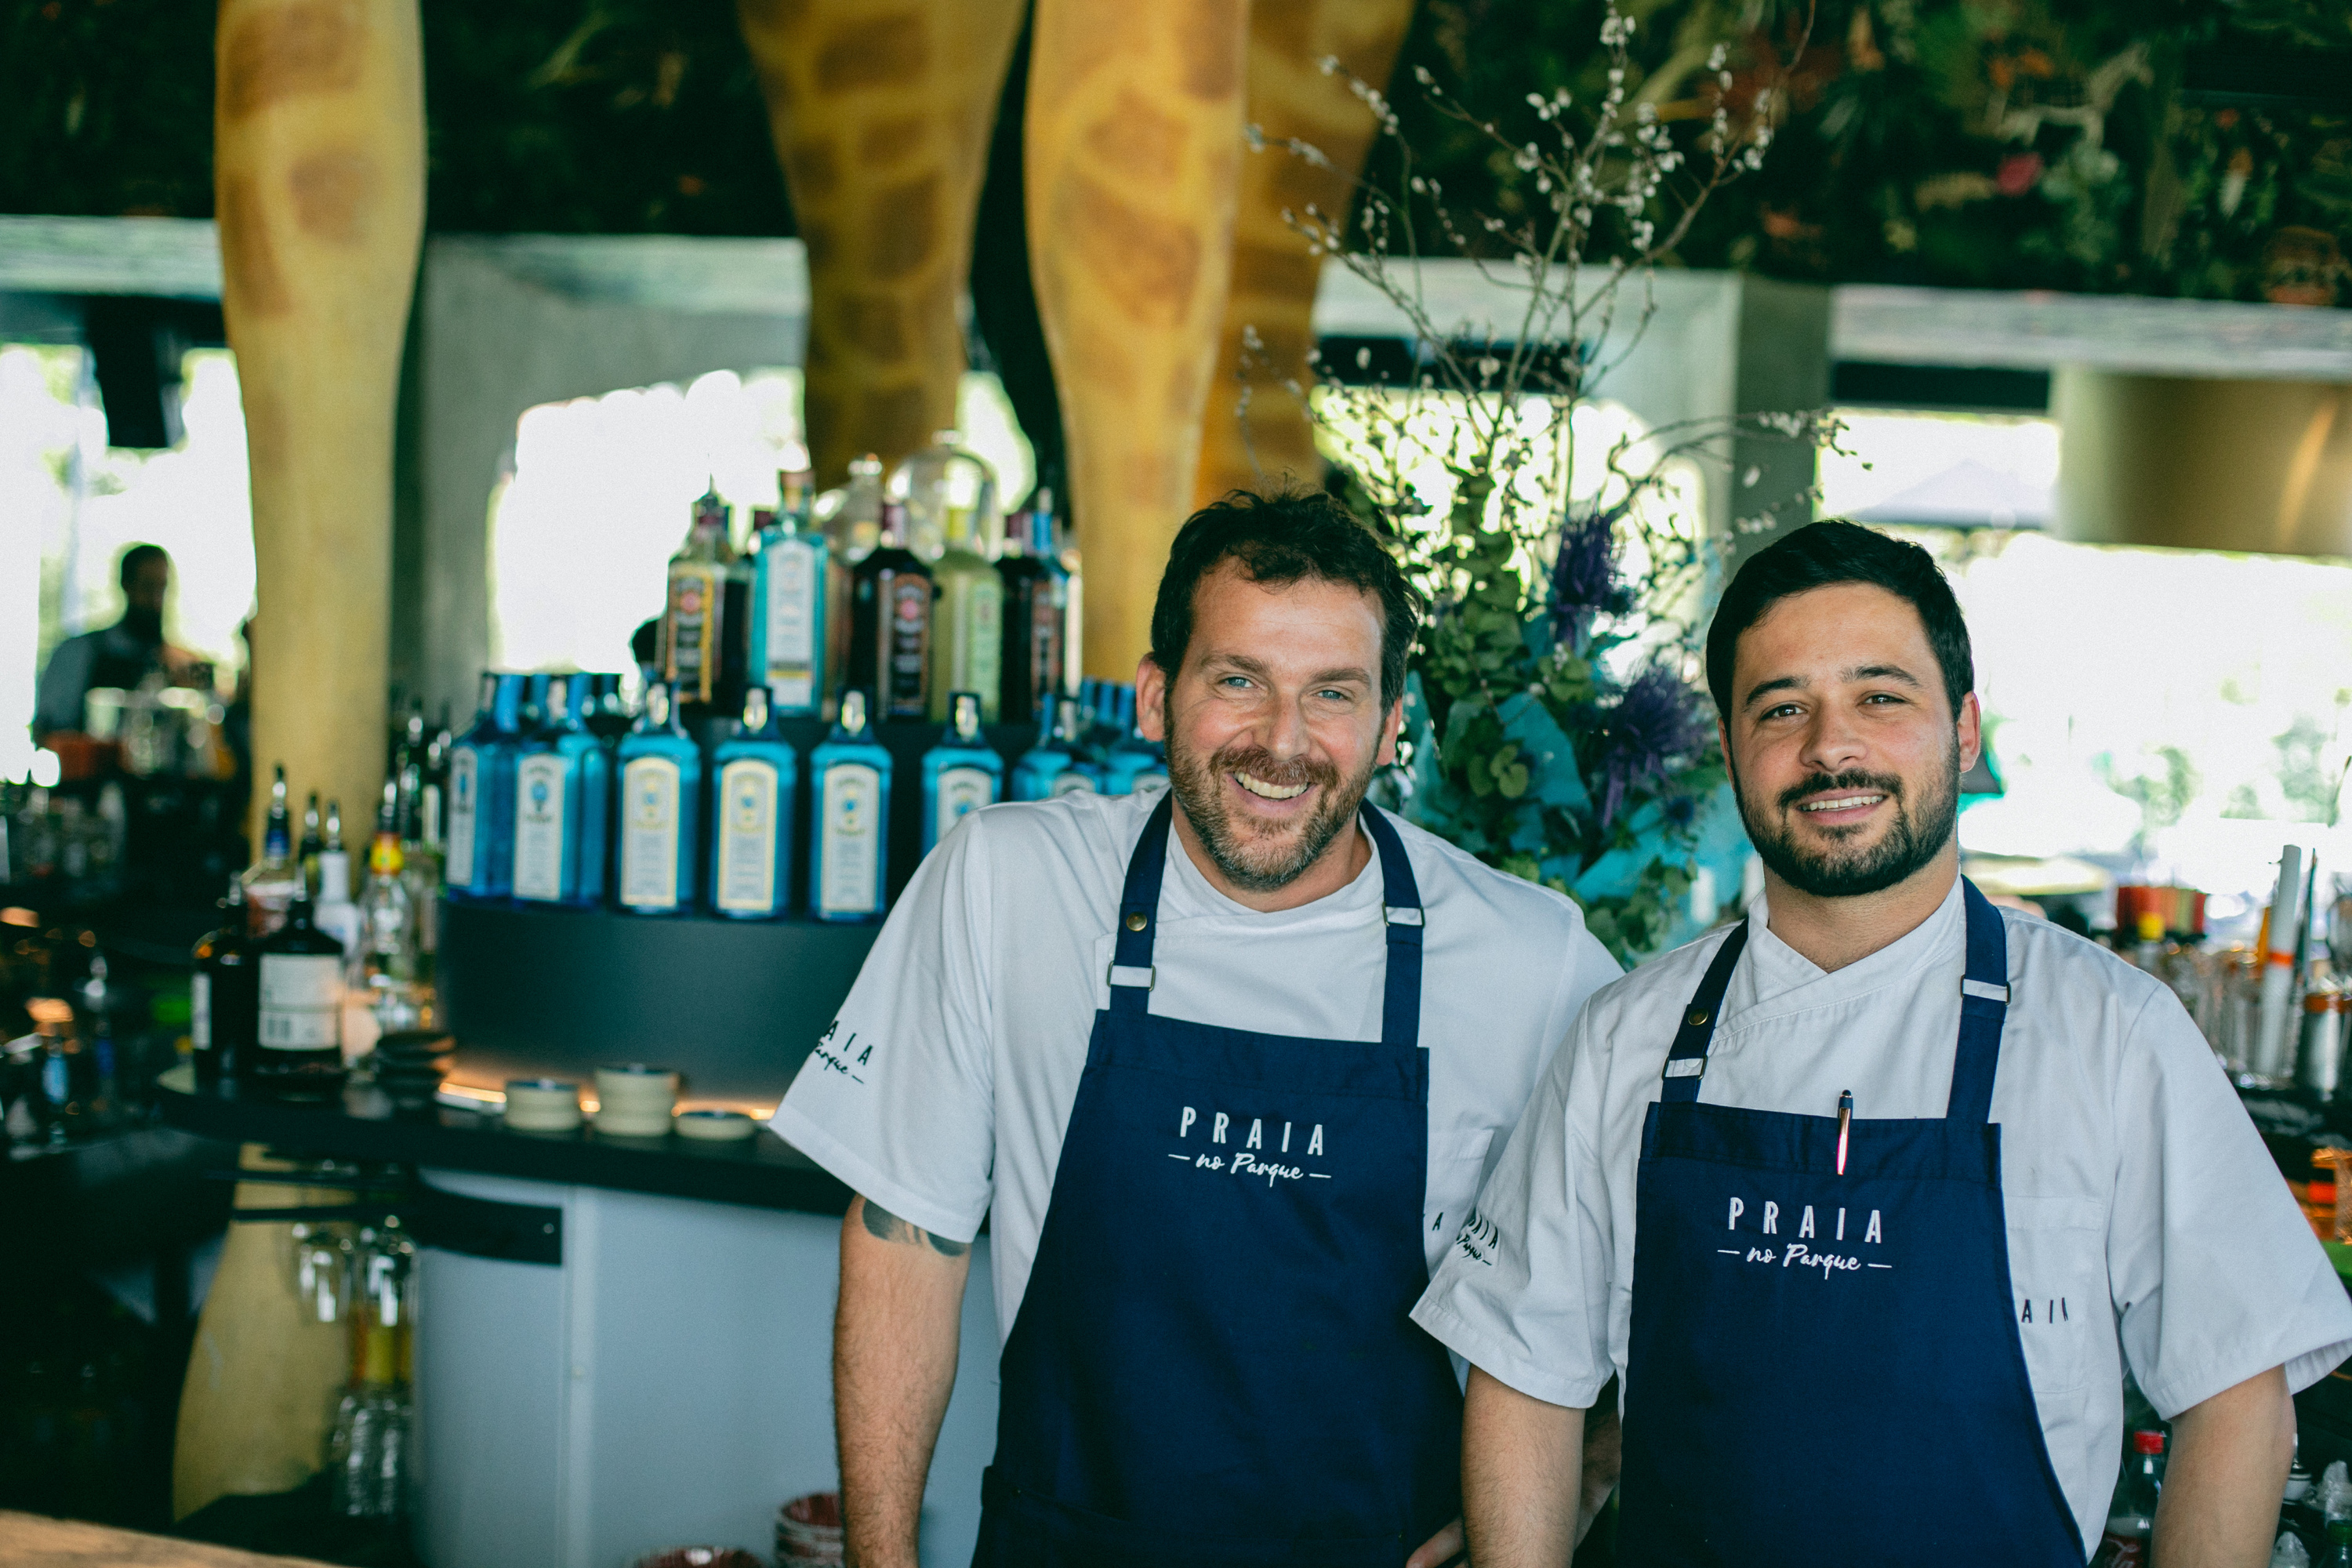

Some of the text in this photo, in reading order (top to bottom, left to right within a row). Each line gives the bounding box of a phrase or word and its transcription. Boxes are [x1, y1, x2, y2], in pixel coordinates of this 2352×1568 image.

[815, 1041, 848, 1074] arque
[822, 1020, 873, 1066] AIA
[1179, 1106, 1323, 1156] PRAIA
[1196, 1152, 1304, 1188] no Parque
[1727, 1196, 1882, 1244] PRAIA
[1746, 1243, 1861, 1280] no Parque
